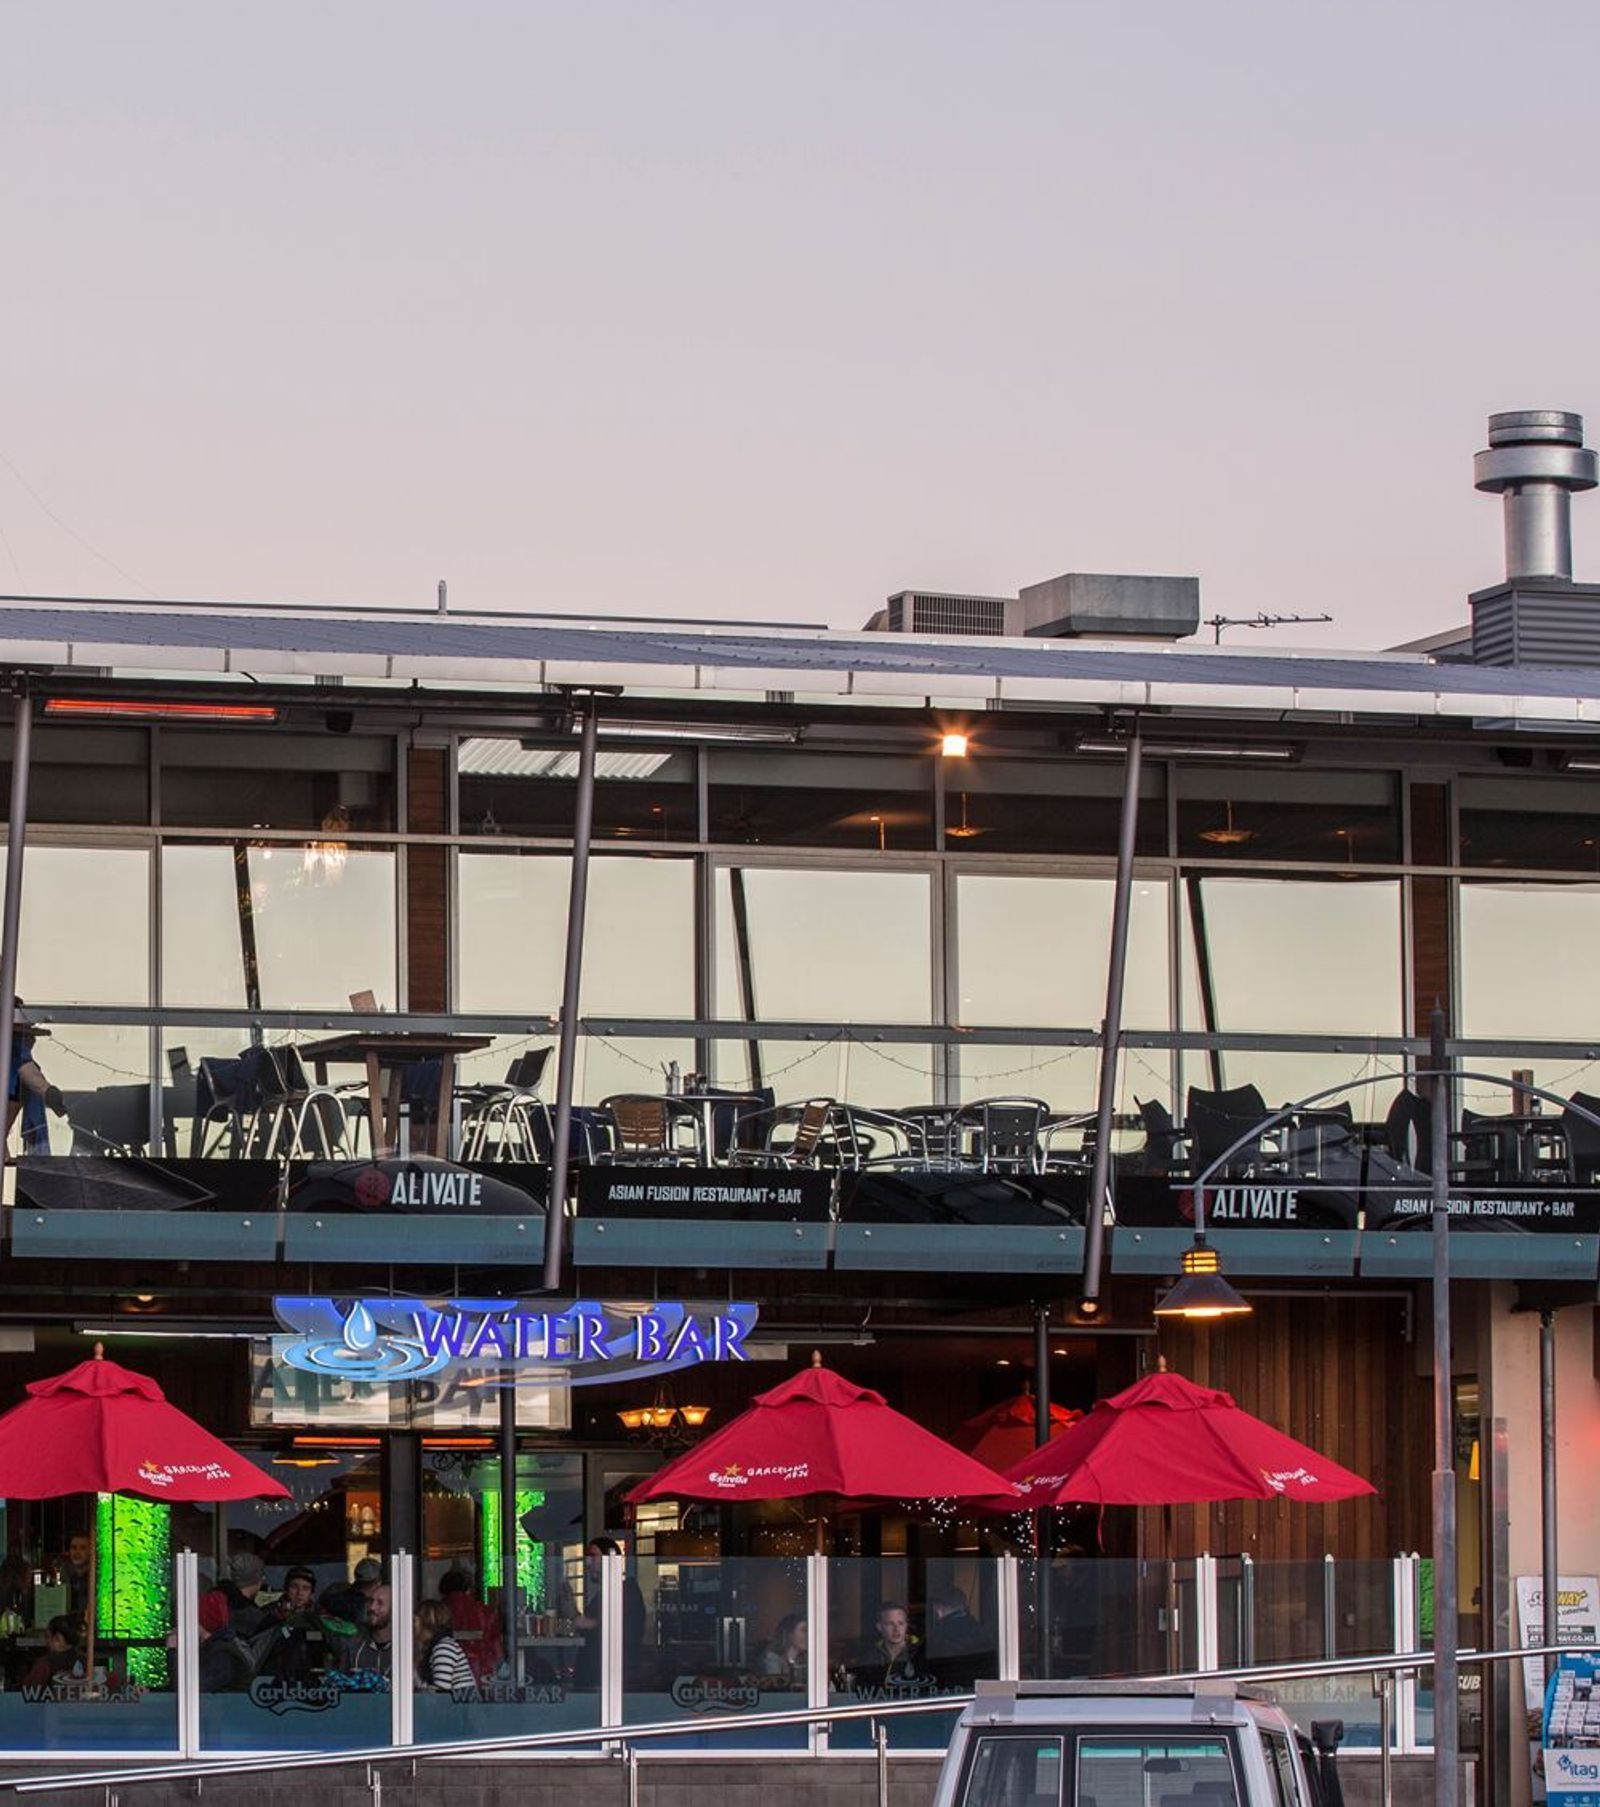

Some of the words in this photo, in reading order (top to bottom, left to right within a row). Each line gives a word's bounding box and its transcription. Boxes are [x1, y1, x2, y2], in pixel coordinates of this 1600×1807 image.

[391, 1172, 483, 1205] ALIVATE
[608, 1185, 644, 1200] ASIAN
[646, 1186, 690, 1201] FUSION
[1212, 1188, 1298, 1219] ALIVATE
[1394, 1199, 1427, 1214] ASIAN
[1429, 1200, 1470, 1214] SION
[411, 1311, 610, 1361] WATER
[634, 1313, 752, 1362] BAR
[249, 1675, 341, 1707] Carlsberg
[452, 1685, 519, 1703] WATER
[525, 1685, 564, 1703] BAR
[671, 1675, 759, 1707] Carlsberg
[1569, 1763, 1598, 1779] itag
